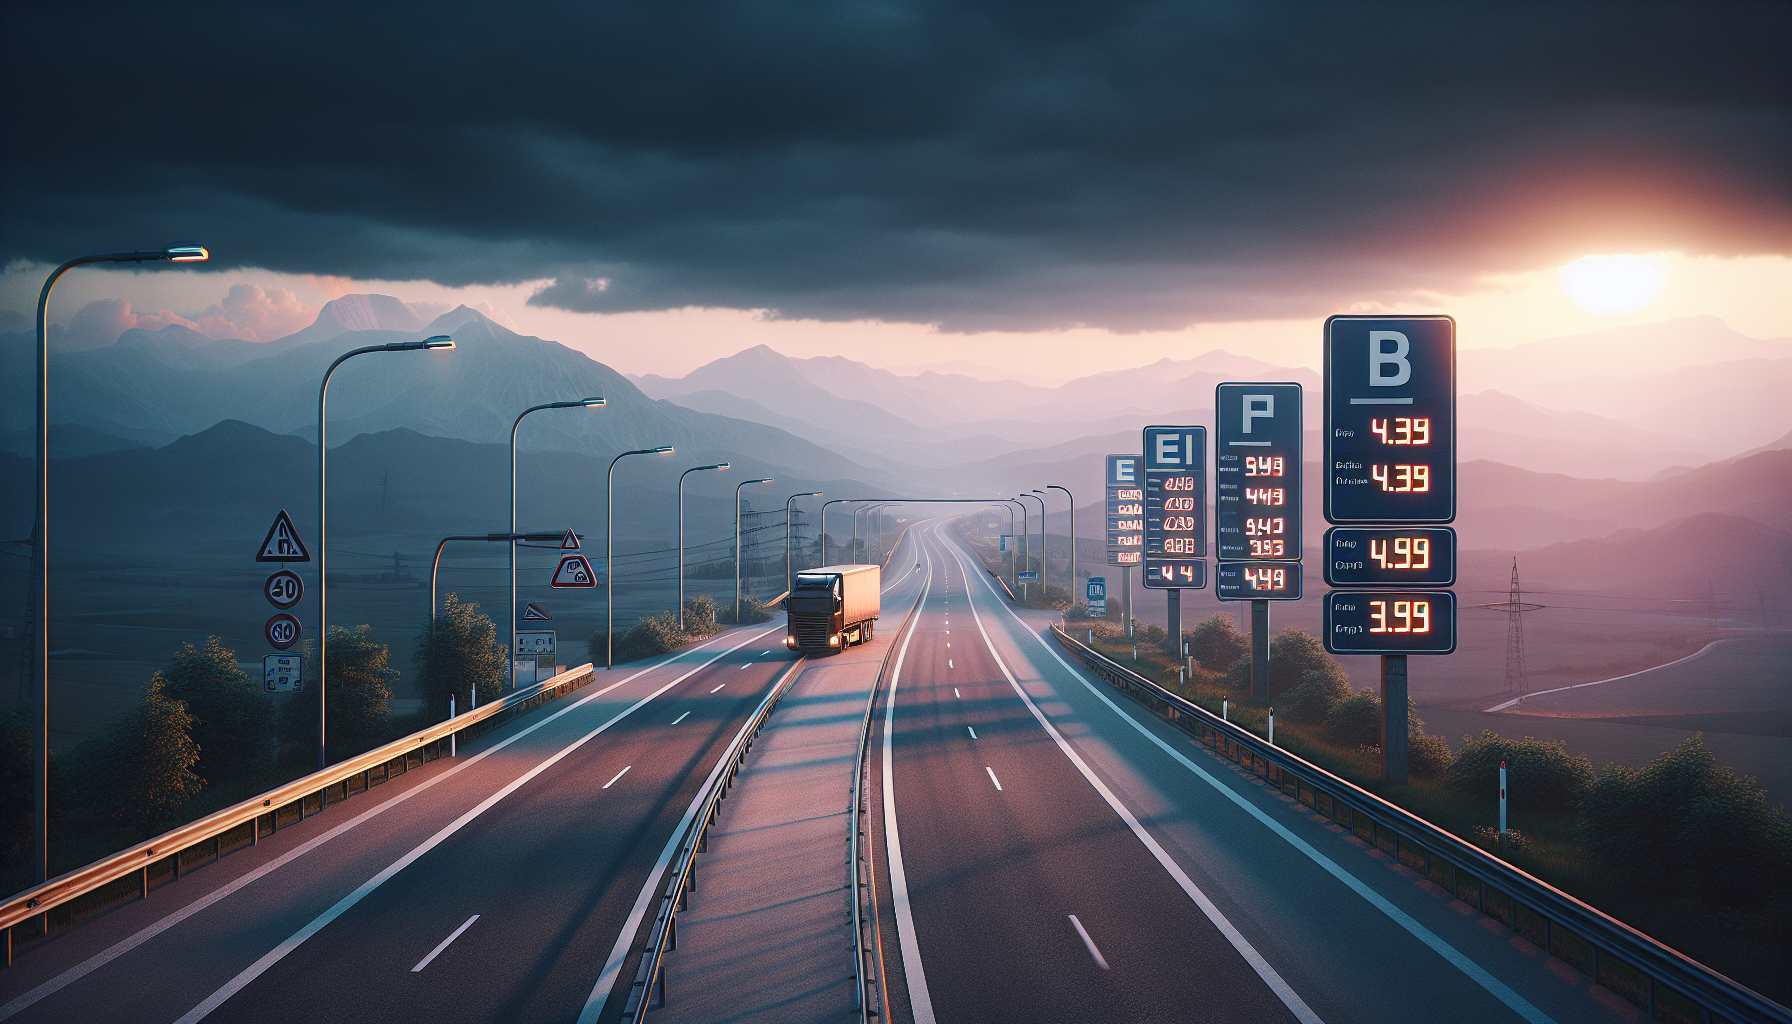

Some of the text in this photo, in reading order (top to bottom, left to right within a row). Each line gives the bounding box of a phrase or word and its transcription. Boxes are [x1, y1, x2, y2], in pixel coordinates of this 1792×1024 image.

[1369, 330, 1412, 387] B
[1242, 394, 1275, 434] P
[1371, 417, 1430, 445] 4.39
[1116, 459, 1135, 481] E
[1371, 463, 1430, 492] 4.39
[1370, 537, 1430, 569] 4.99
[1369, 600, 1430, 633] 3.99
